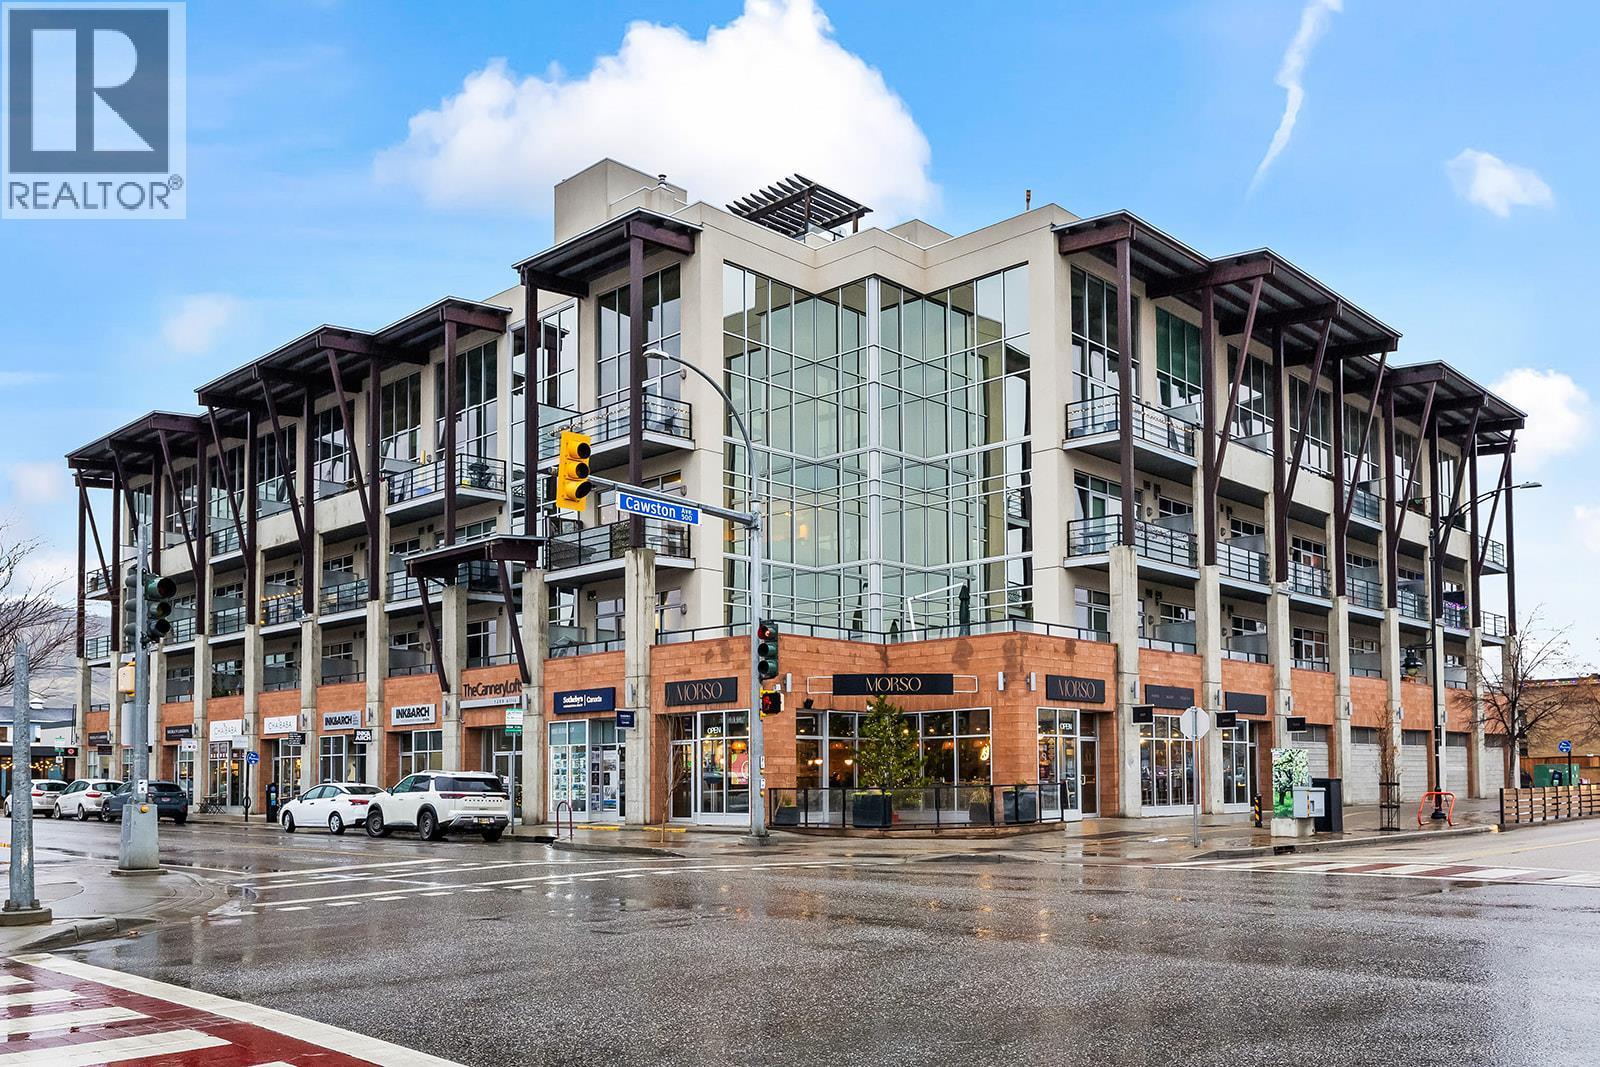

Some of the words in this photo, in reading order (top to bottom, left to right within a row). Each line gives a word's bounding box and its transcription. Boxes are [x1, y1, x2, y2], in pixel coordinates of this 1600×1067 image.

[625, 496, 676, 518] Cawston
[681, 513, 693, 521] 500
[677, 681, 722, 701] MORSO
[866, 677, 921, 692] MORSO
[1058, 679, 1096, 698] MORSO
[396, 706, 429, 719] INK&ARCH
[706, 726, 721, 734] OPEN
[1060, 722, 1072, 730] OPEN
